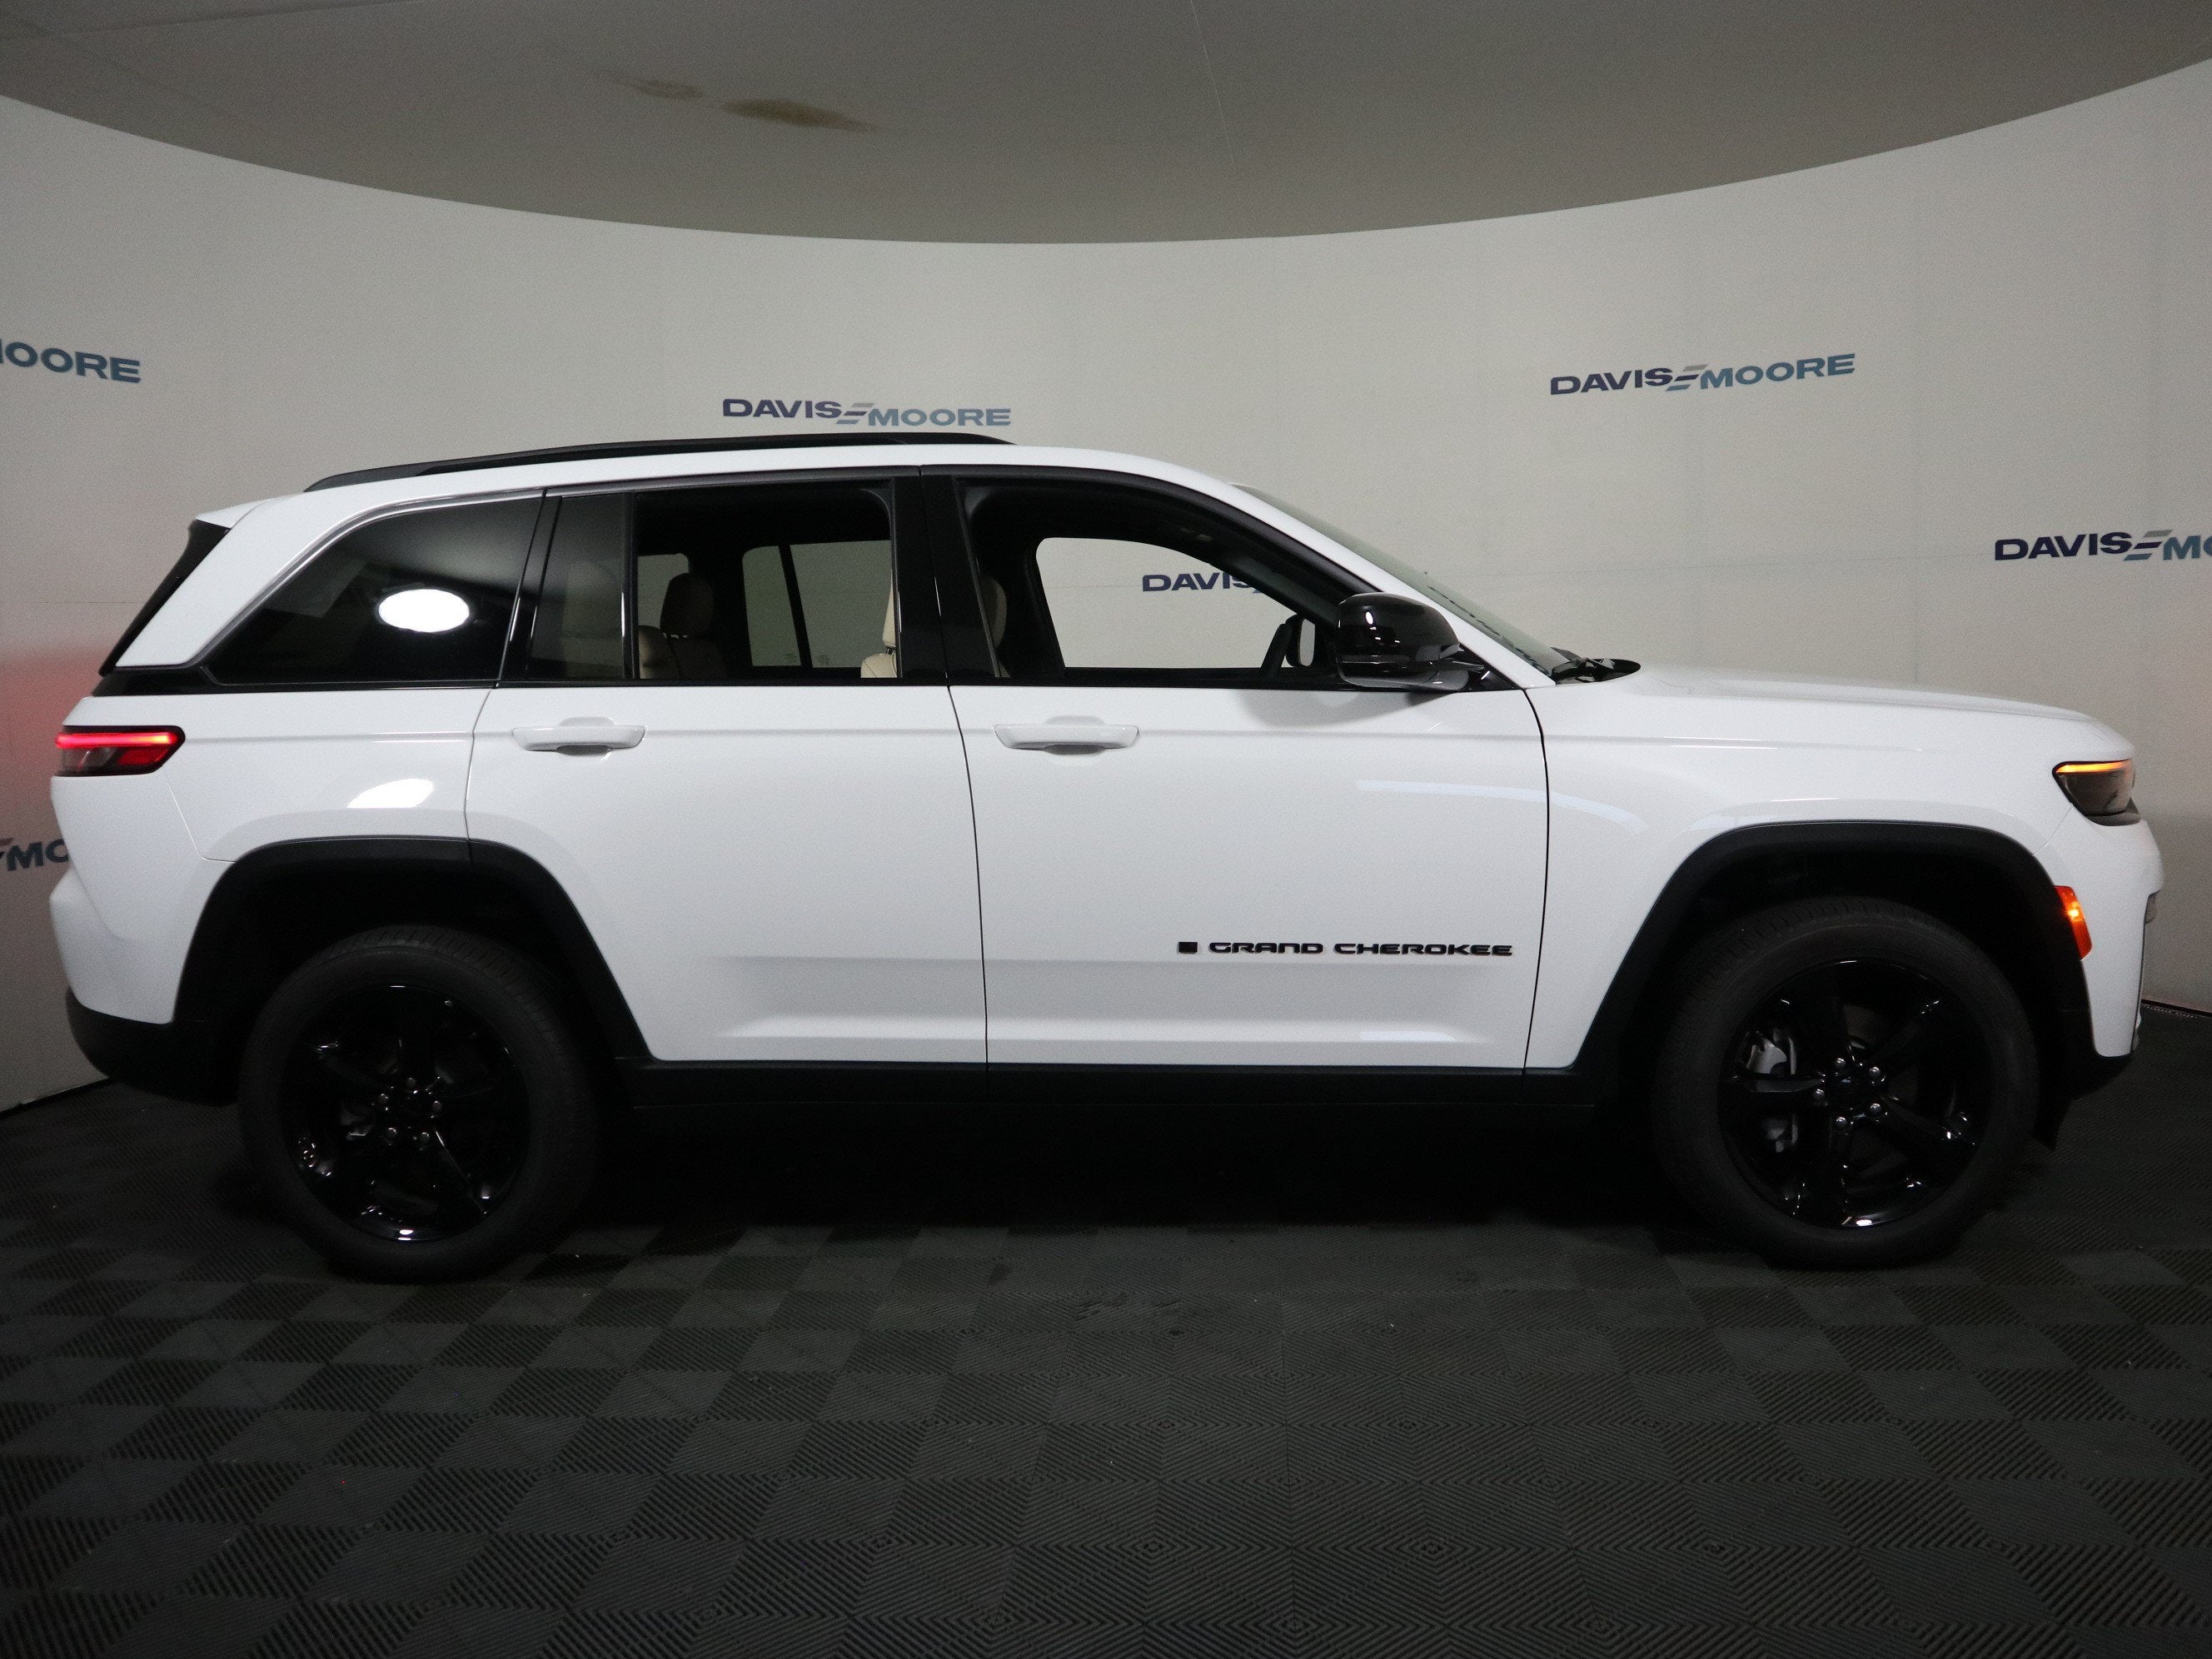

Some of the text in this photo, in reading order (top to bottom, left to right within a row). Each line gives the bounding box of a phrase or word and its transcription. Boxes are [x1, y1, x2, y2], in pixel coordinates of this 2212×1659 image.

[0, 337, 142, 384] OORE
[1550, 353, 1856, 396] DAVIS MOORE
[722, 398, 1012, 427] DAVIS MOORE
[1995, 531, 2212, 560] DAVIS M
[1208, 942, 1512, 957] GRAND CHEROKEE
